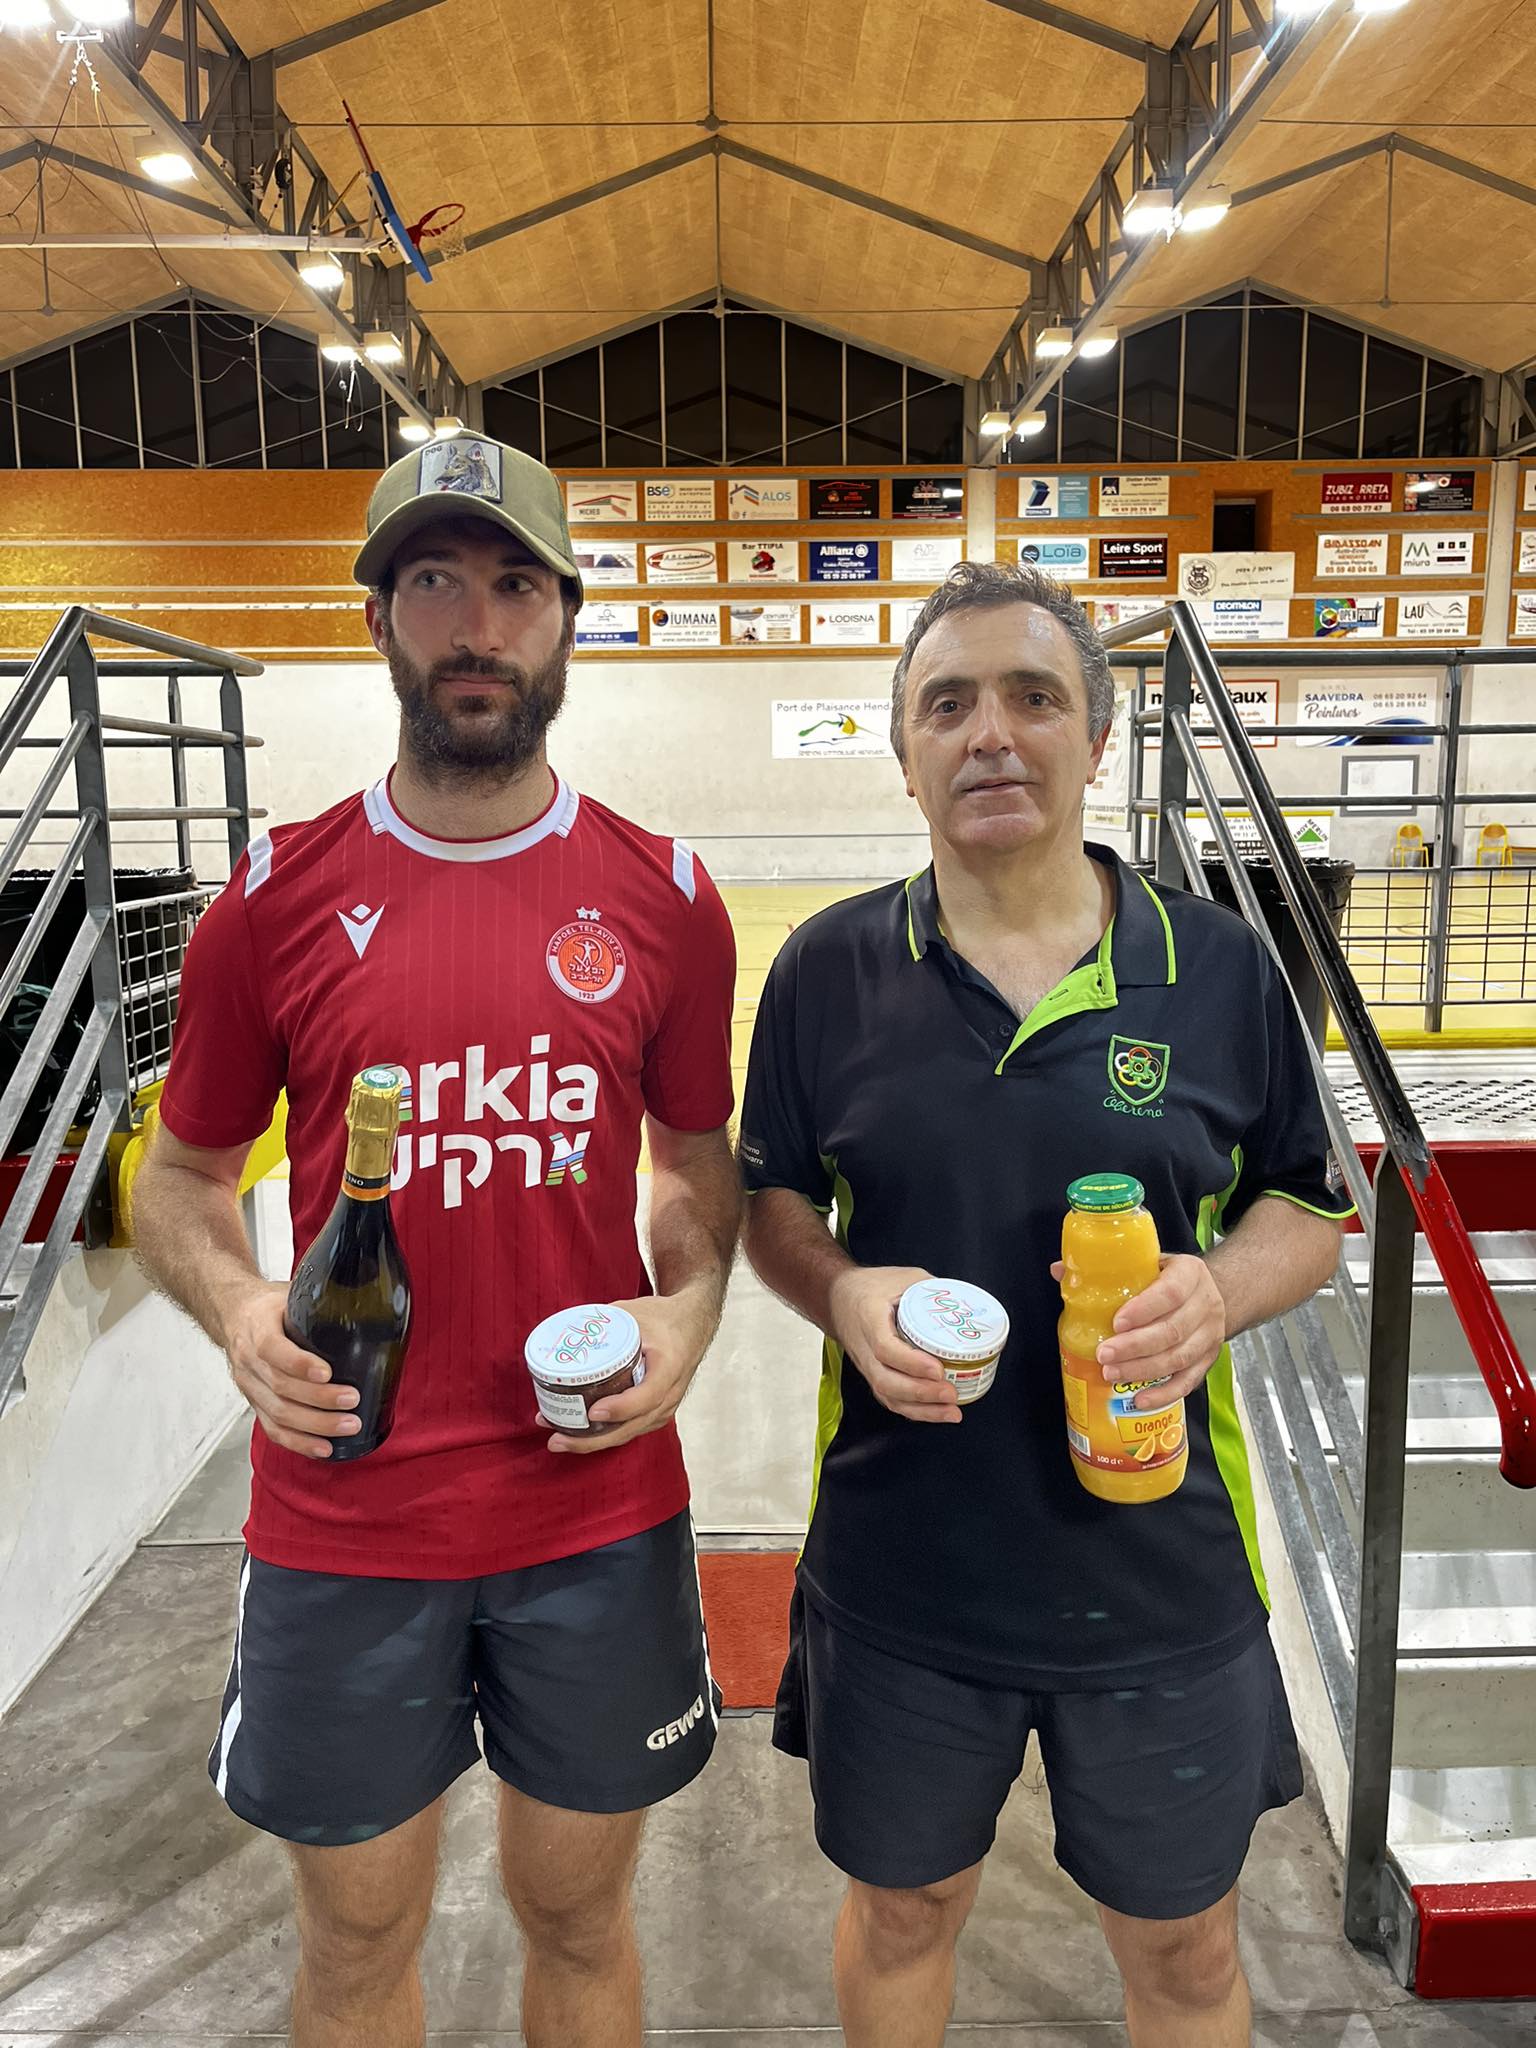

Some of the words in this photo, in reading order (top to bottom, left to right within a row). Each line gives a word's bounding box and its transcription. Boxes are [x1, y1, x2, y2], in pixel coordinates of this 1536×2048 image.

[762, 491, 792, 501] ALOS
[820, 546, 854, 556] Allianz
[1103, 543, 1131, 554] Leire
[1132, 543, 1163, 555] Sport
[1304, 693, 1364, 702] SAAVEDRA
[776, 703, 798, 712] Port
[800, 703, 813, 712] de
[816, 702, 860, 712] Plaisance
[864, 702, 890, 711] Hend
[552, 926, 578, 952] HAPOEL
[578, 925, 615, 945] TEL-AVIV
[578, 992, 595, 1000] 1923
[1134, 1413, 1173, 1434] Orange
[1096, 1456, 1109, 1464] 100
